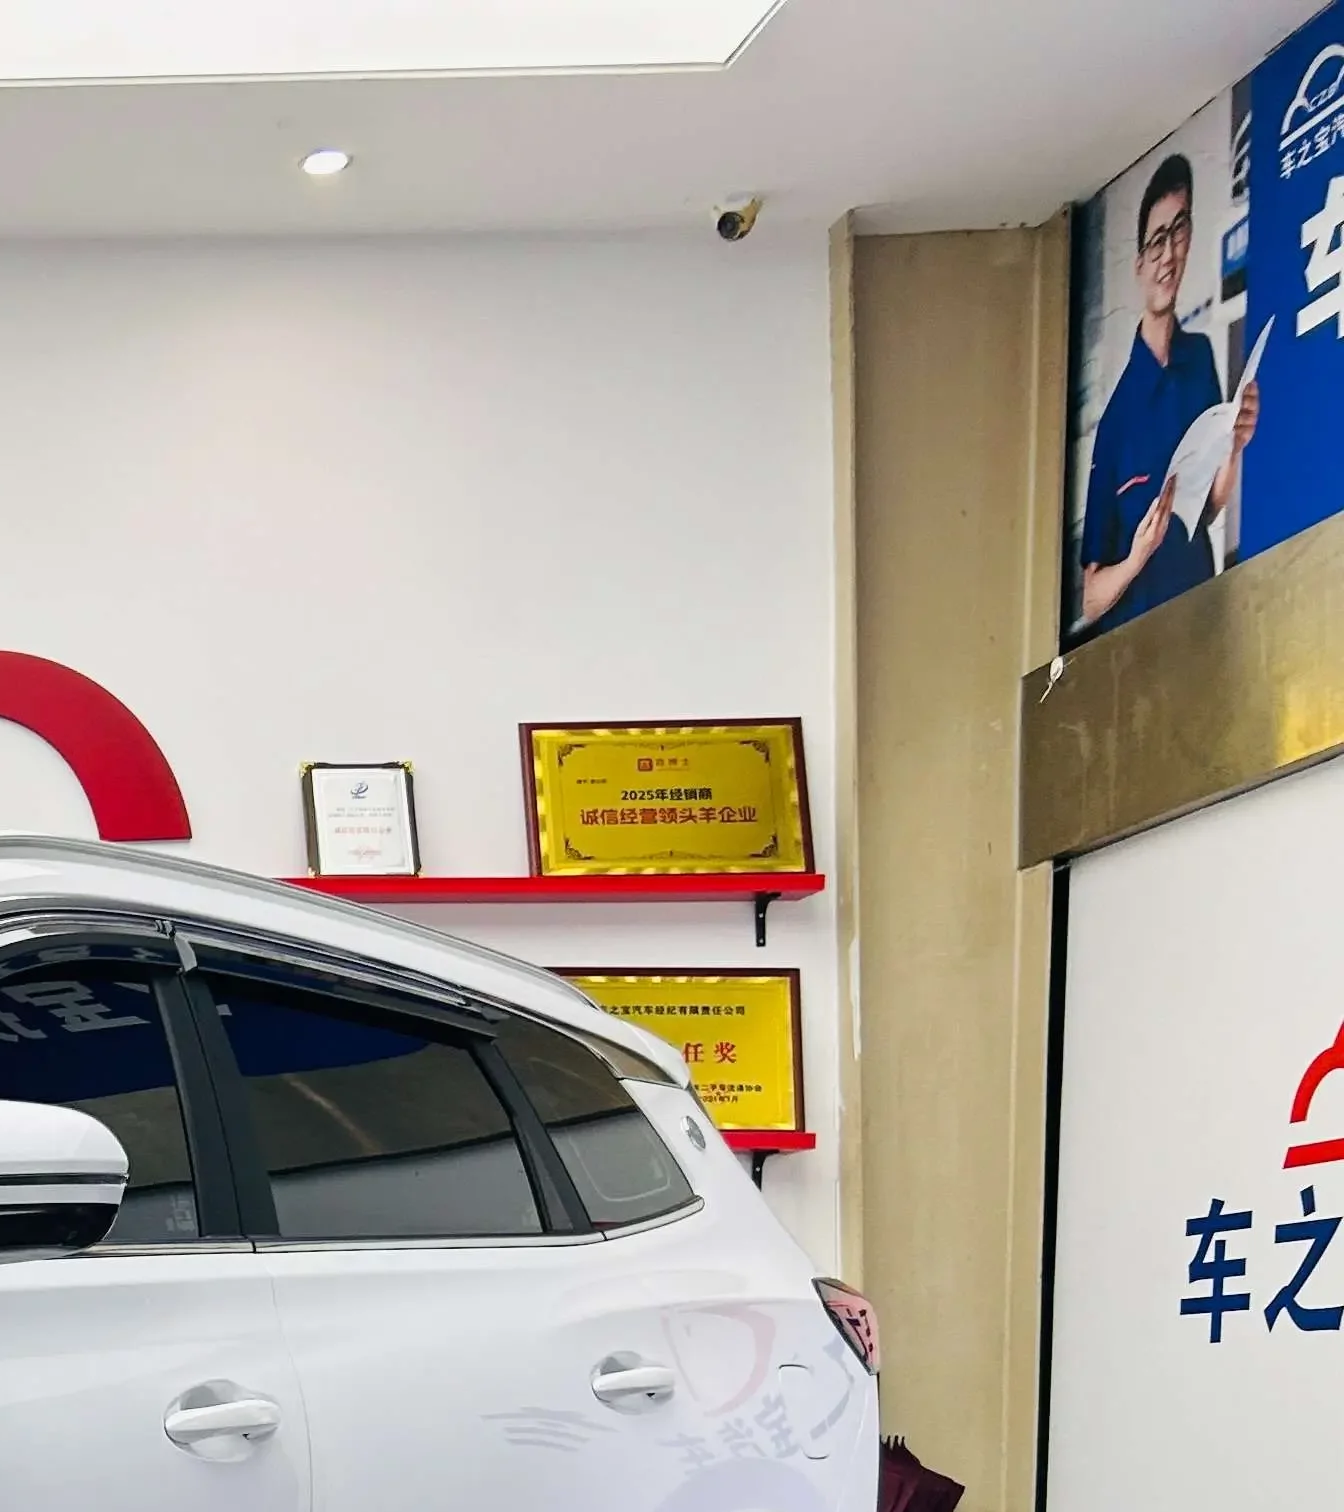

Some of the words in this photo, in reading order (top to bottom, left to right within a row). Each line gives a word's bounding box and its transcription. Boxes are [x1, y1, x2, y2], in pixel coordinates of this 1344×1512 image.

[620, 787, 713, 801] 2025年经销商
[579, 806, 759, 826] 诚信经营领头羊企业
[1180, 1185, 1344, 1343] 车之
